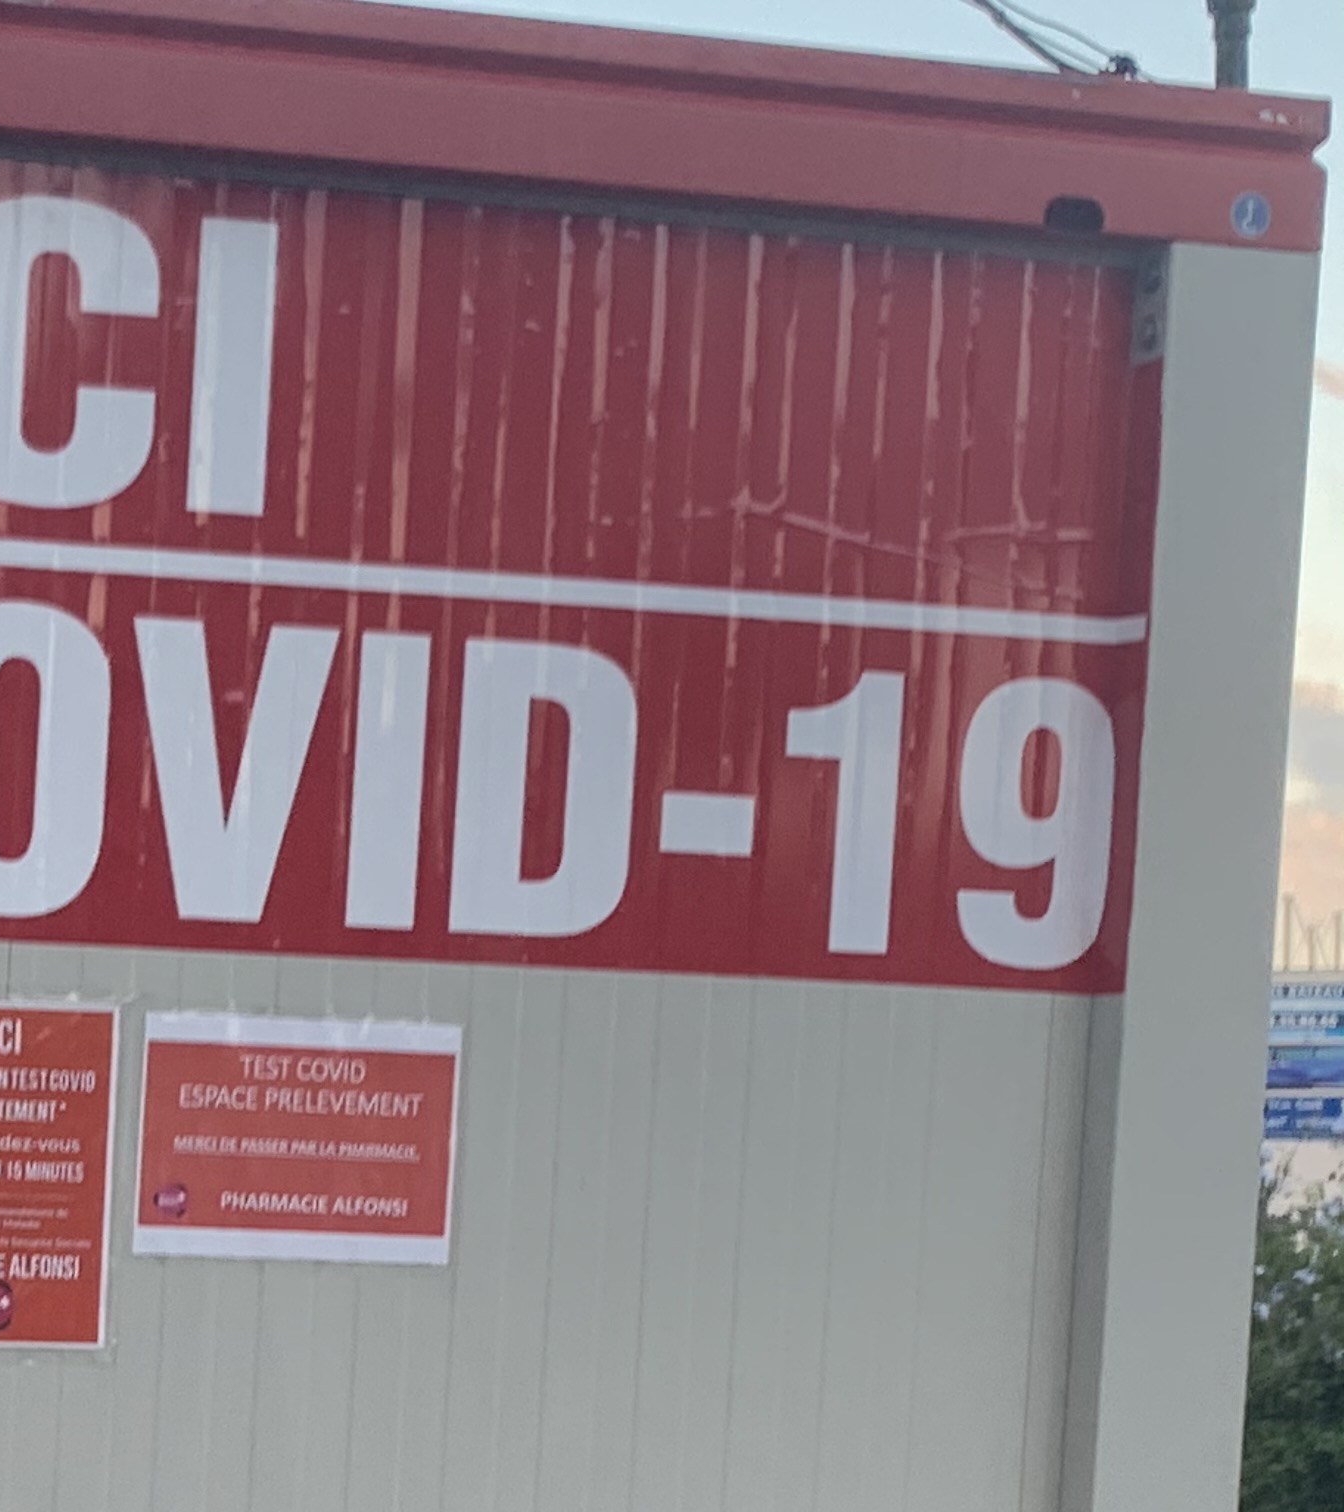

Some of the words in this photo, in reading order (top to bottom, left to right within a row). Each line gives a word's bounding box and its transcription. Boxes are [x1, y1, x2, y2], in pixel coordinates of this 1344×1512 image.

[12, 1067, 46, 1092] TEST
[49, 1068, 96, 1093] COVID
[239, 1054, 292, 1081] TEST
[296, 1056, 366, 1084] COVID
[179, 1083, 258, 1111] ESPACE
[264, 1087, 424, 1118] PRELEVEMENT
[173, 1134, 217, 1152] MERCI
[219, 1136, 238, 1153] DE
[240, 1136, 289, 1155] PASSER
[319, 1140, 338, 1158] LA
[24, 1160, 84, 1183] MINUTES
[220, 1190, 327, 1214] PHARMACIE
[331, 1194, 408, 1218] ALFONSI
[9, 1254, 81, 1280] ALFONSI
